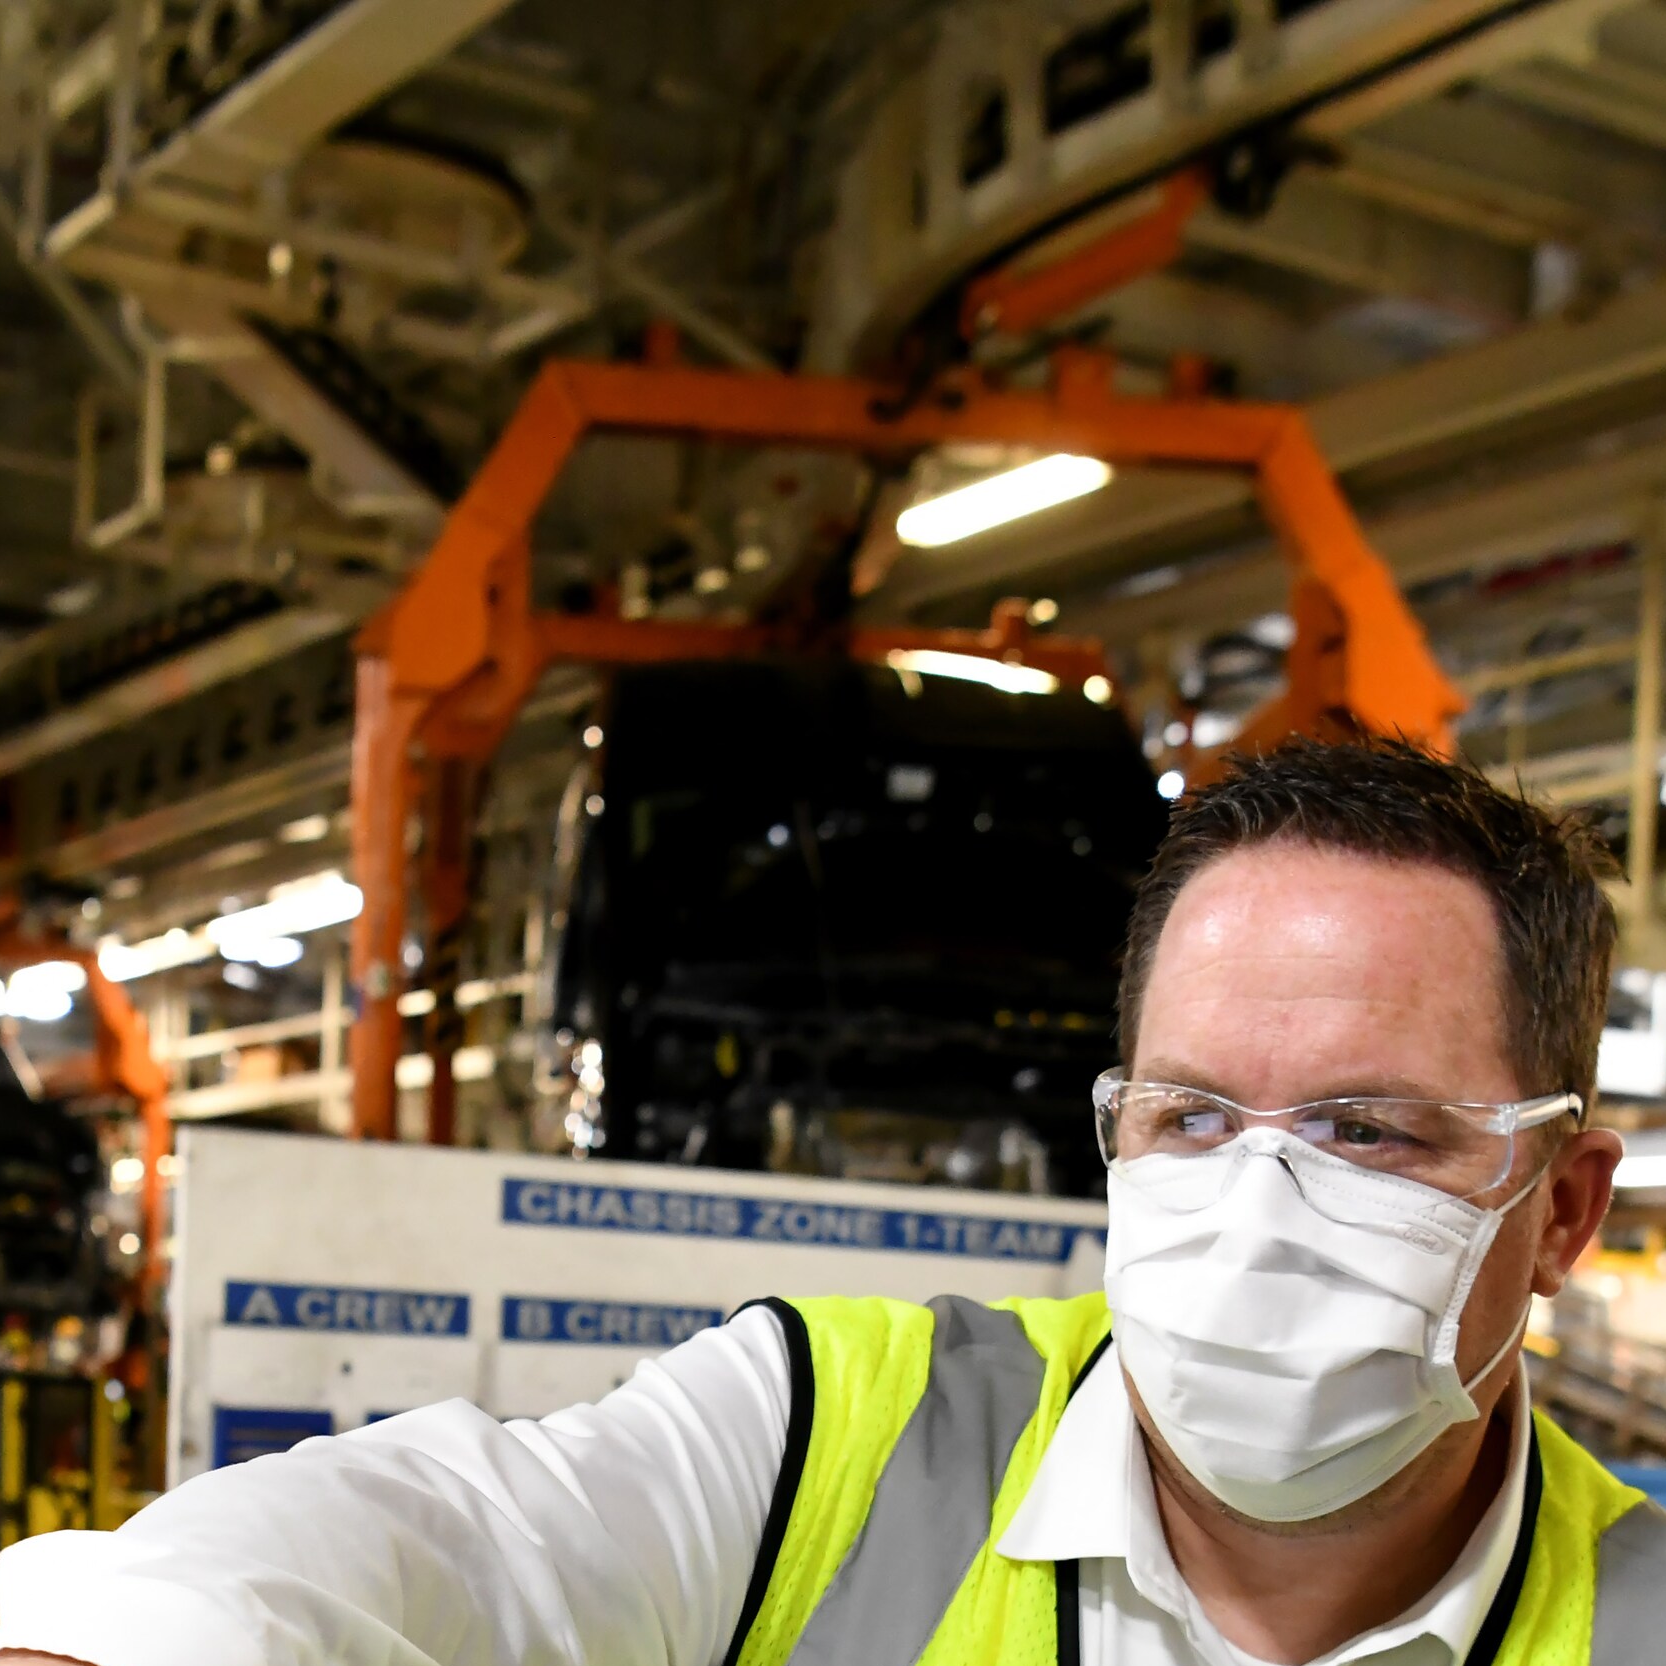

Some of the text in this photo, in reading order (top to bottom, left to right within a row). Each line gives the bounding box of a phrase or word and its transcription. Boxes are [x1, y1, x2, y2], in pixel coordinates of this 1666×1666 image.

[517, 1183, 1062, 1257] CHASSIS ZONE 1-TEAM
[1403, 1225, 1438, 1251] Ford
[241, 1288, 458, 1333] A CREW
[517, 1302, 715, 1345] B CREW
